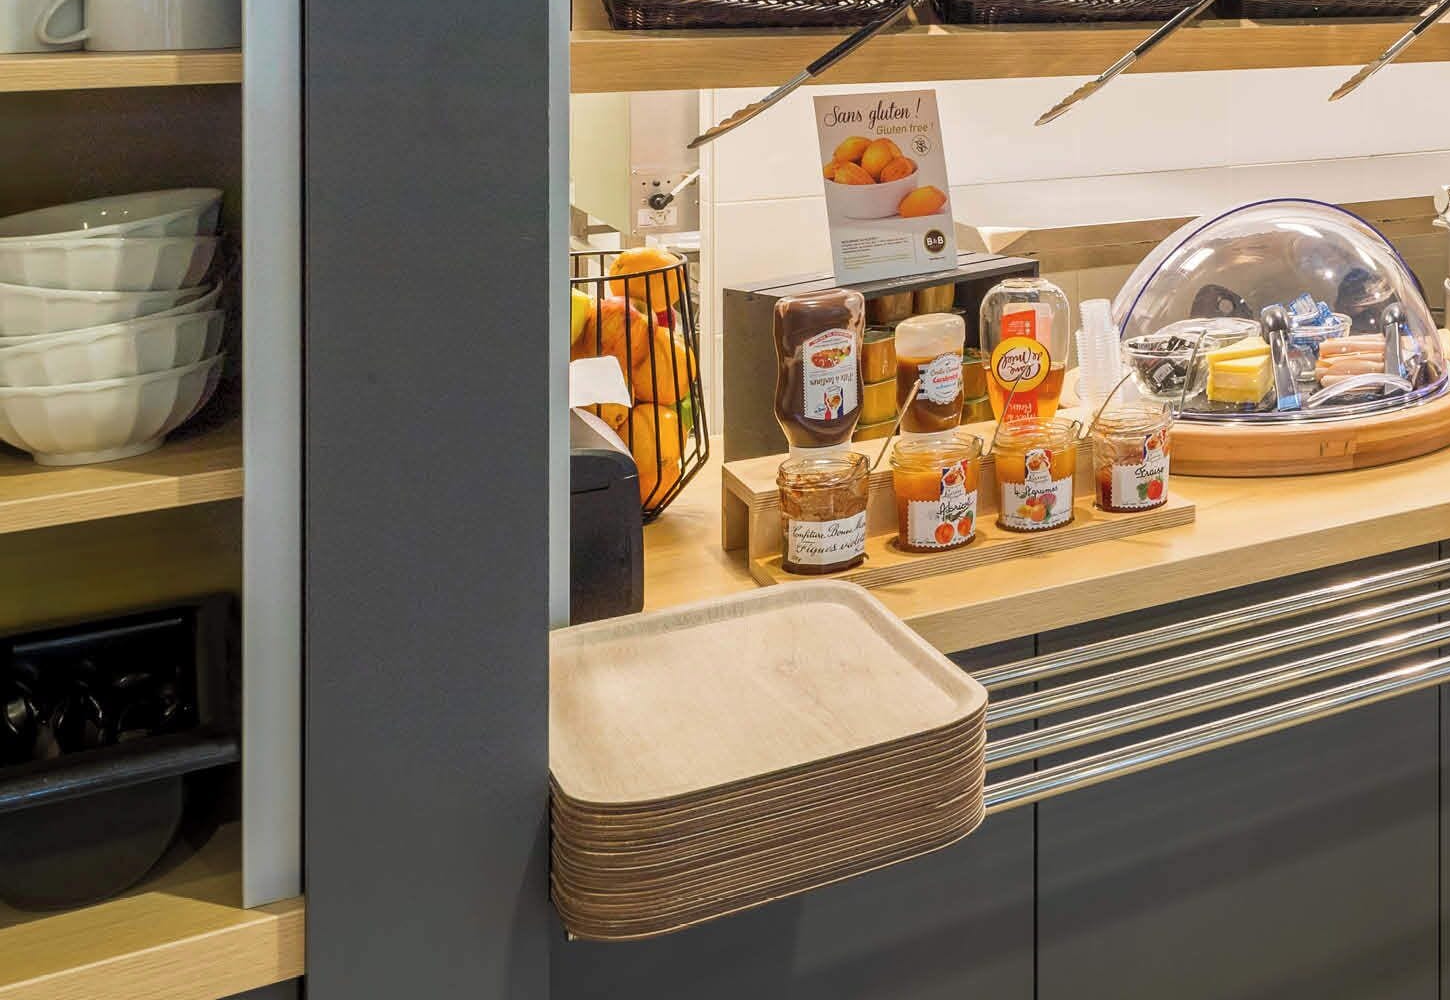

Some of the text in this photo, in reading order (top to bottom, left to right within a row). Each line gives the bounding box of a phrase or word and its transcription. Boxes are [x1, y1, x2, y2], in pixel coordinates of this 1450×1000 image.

[823, 105, 862, 127] Sans
[868, 100, 911, 130] gluten
[876, 124, 907, 135] Gluten
[909, 123, 929, 134] free
